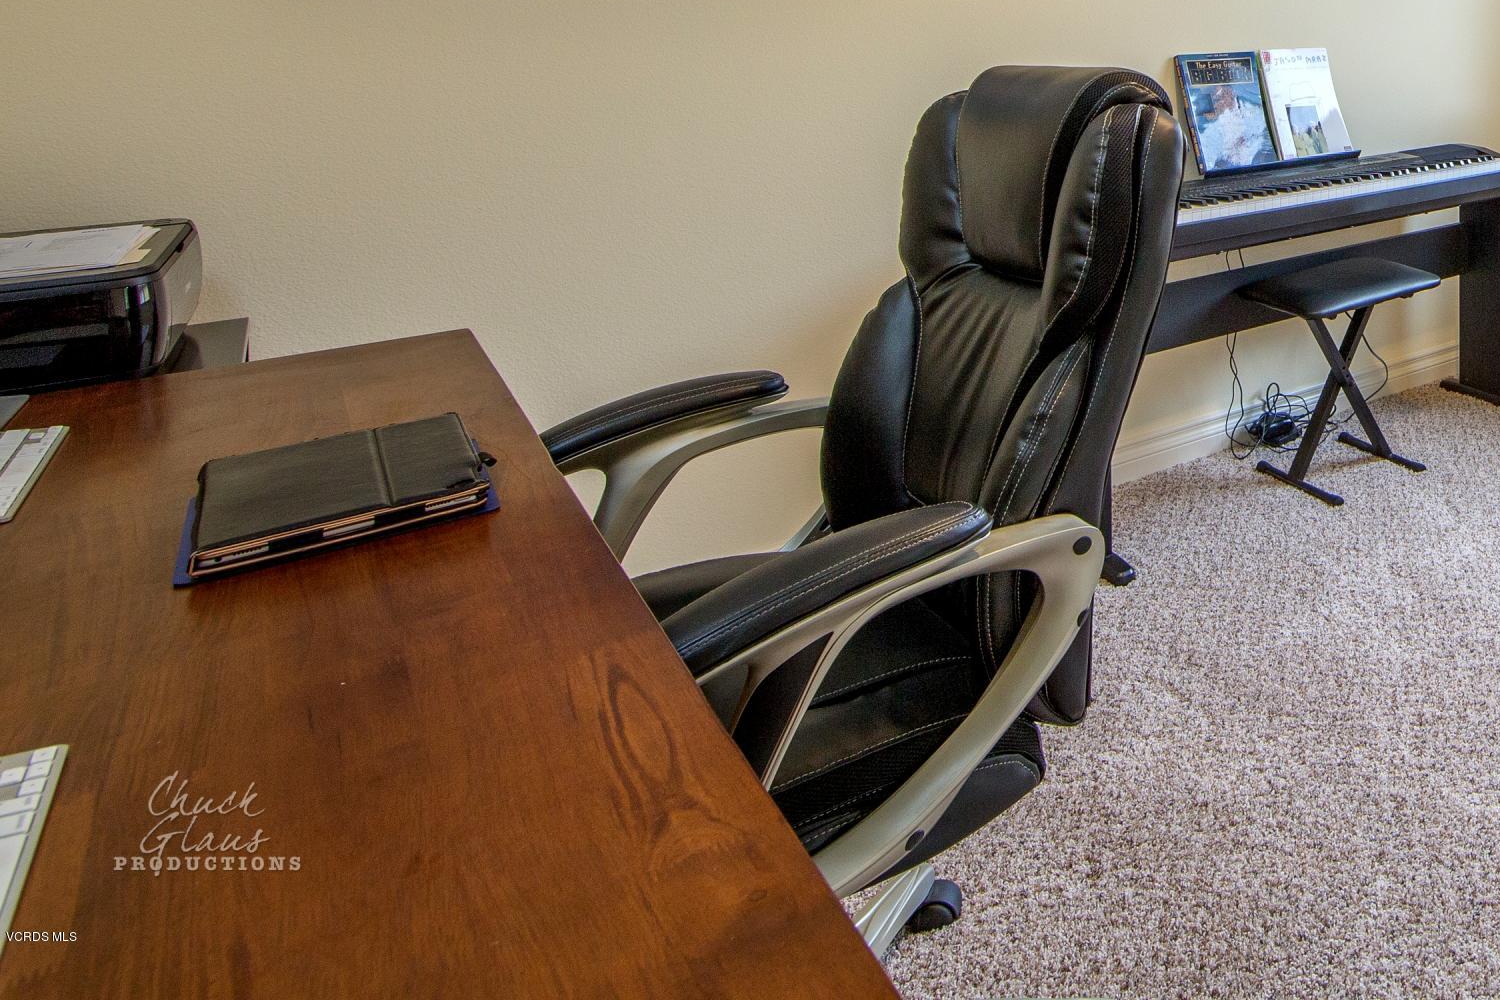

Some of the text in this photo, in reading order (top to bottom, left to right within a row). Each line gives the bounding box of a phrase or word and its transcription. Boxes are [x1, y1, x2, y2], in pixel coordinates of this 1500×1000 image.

[1208, 61, 1221, 69] Easy
[1274, 54, 1326, 66] JASON MRAZ
